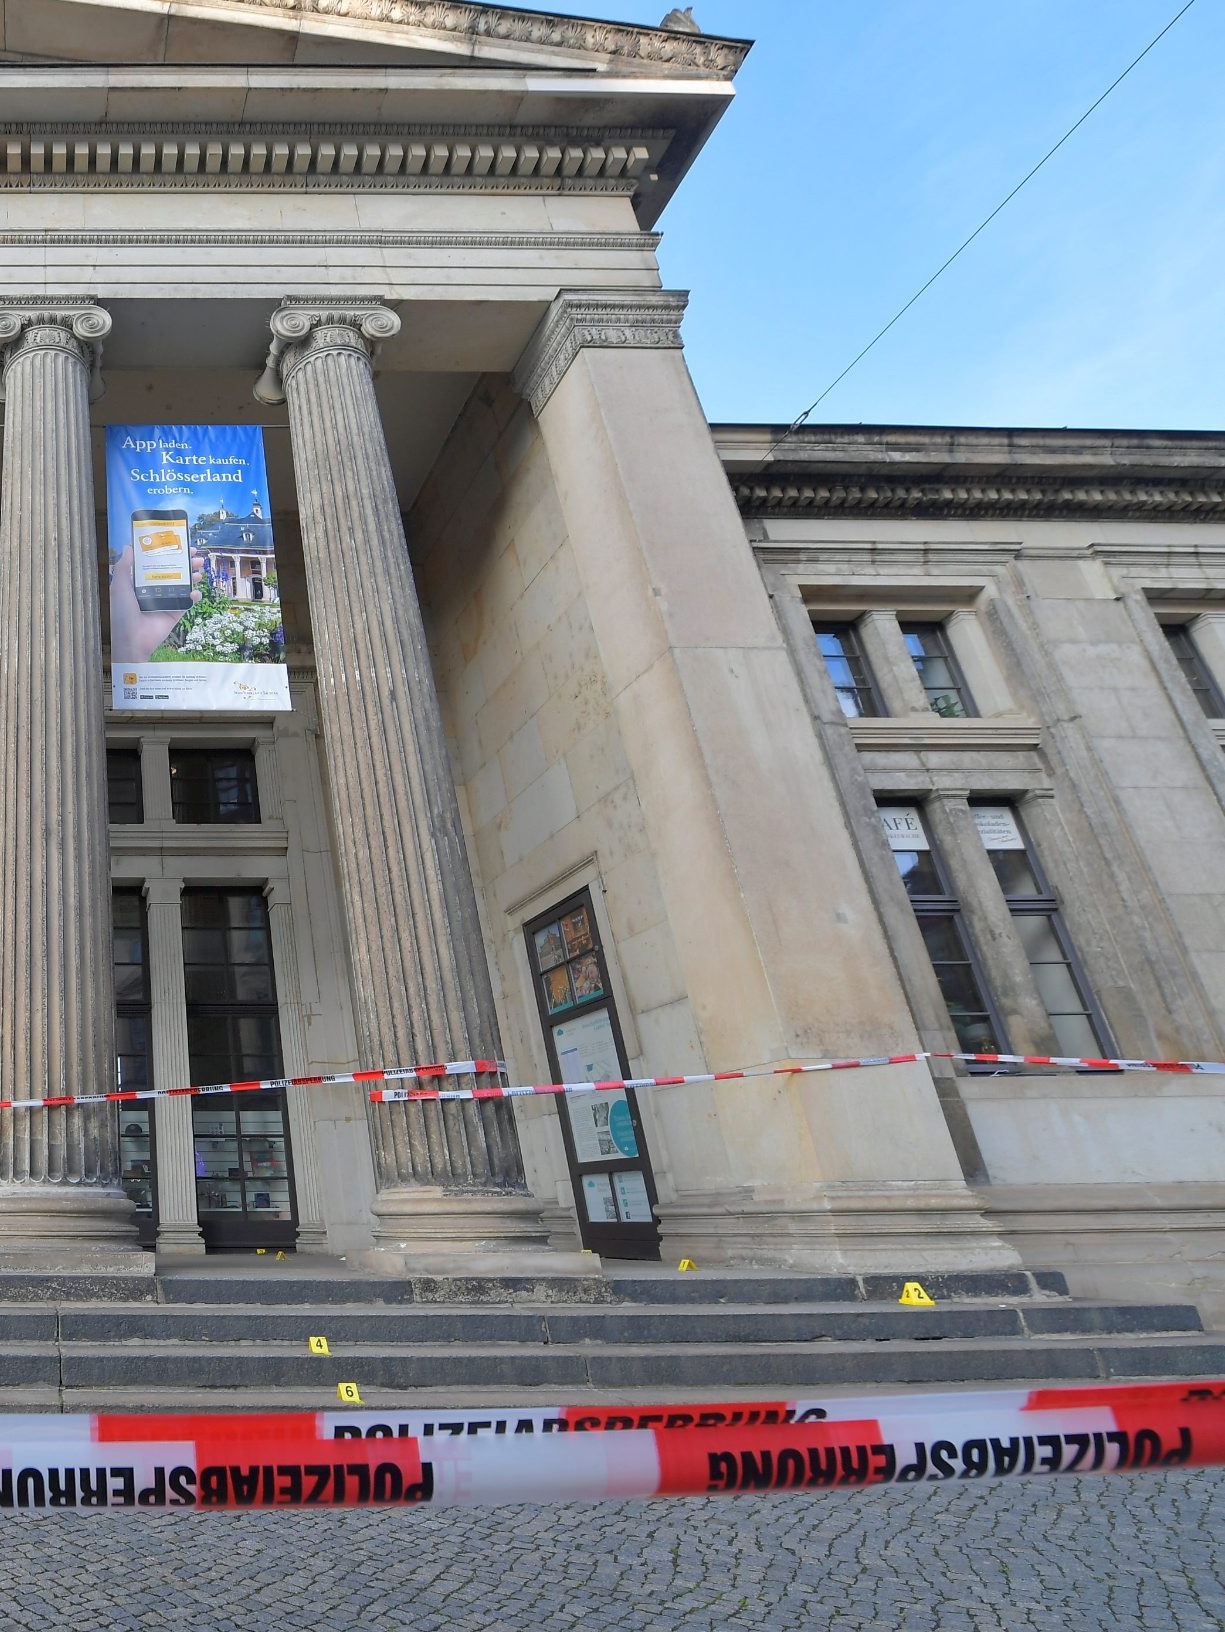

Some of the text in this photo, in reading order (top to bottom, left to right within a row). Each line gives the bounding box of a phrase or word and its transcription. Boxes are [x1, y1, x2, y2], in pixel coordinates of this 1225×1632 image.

[122, 435, 192, 451] App laden.
[161, 451, 250, 466] Karte kaufen.
[130, 468, 243, 483] Schlösserland
[147, 485, 194, 495] erobern.
[883, 813, 918, 831] AFÉ
[914, 1288, 924, 1299] 2
[316, 1338, 323, 1349] 4
[345, 1386, 354, 1397] 6
[708, 1426, 1192, 1492] POLIZEIABSPERRUNG
